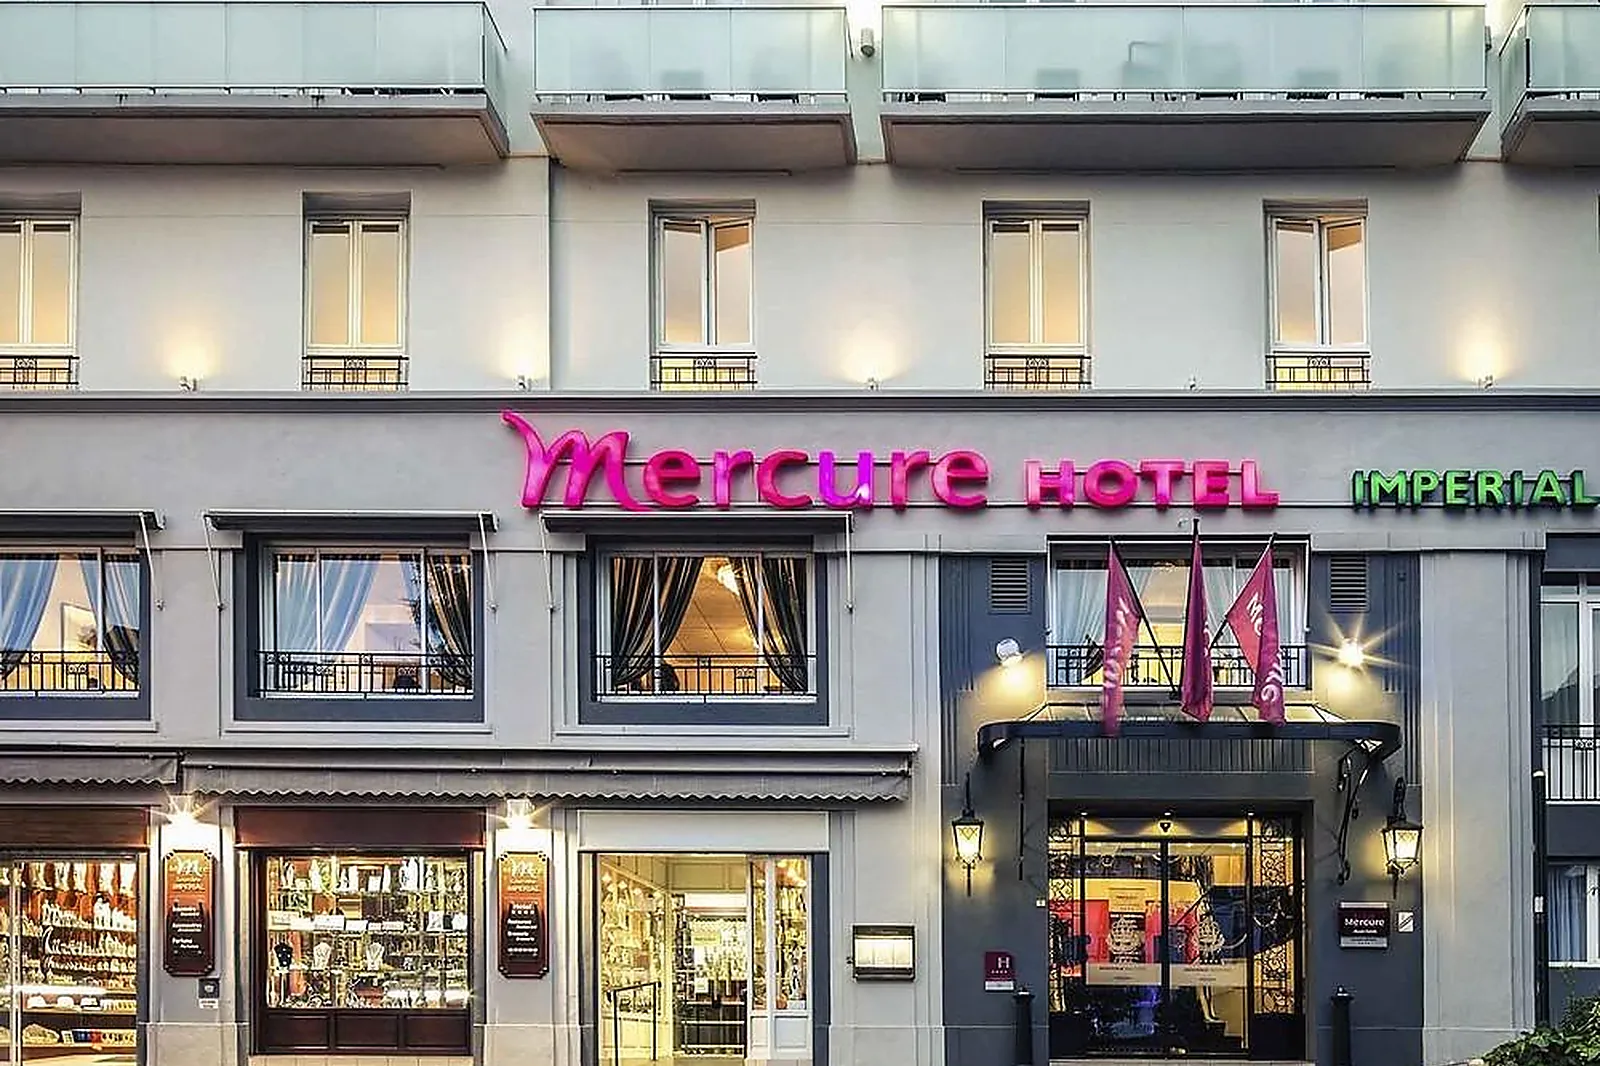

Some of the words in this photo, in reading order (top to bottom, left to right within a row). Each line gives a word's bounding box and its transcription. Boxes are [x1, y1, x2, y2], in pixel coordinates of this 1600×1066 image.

[501, 409, 989, 511] Mercure
[1024, 460, 1279, 508] HOTEL
[1351, 469, 1600, 510] IMPERIAL
[1344, 918, 1385, 926] Mercure
[998, 957, 1010, 968] H
